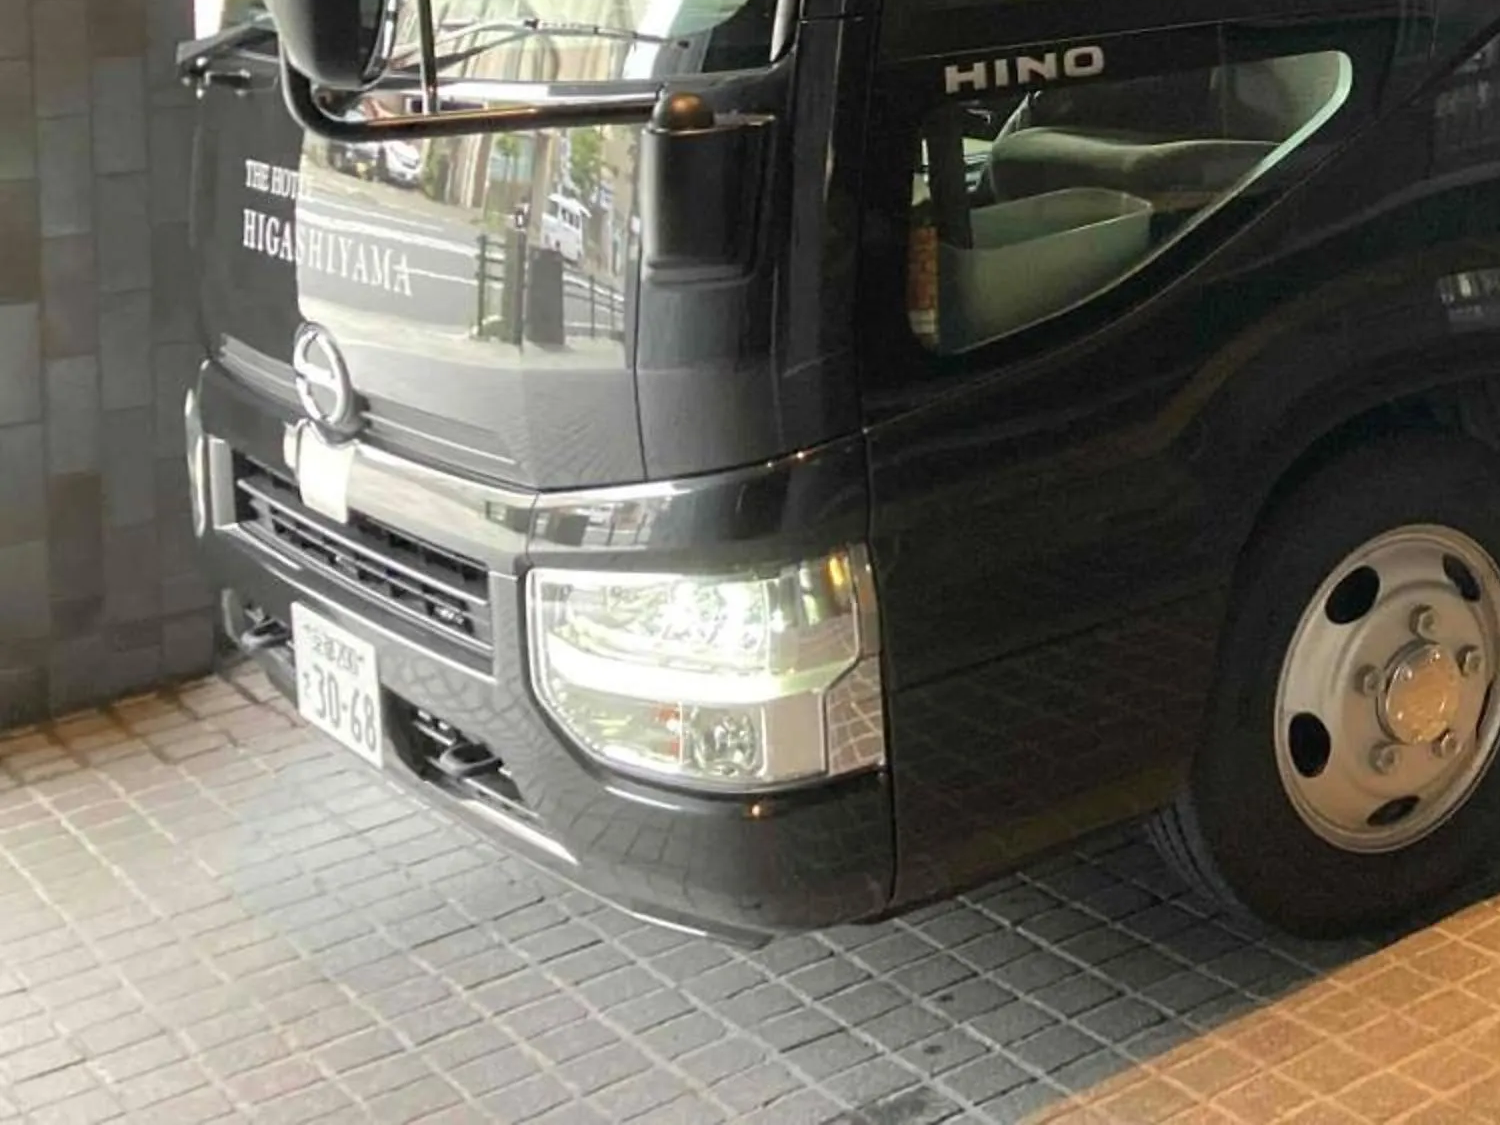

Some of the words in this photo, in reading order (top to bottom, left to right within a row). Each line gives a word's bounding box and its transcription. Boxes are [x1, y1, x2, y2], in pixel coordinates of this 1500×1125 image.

[944, 45, 1105, 94] HINO
[244, 158, 270, 192] THE
[242, 207, 413, 297] HIGASHIYAMA
[312, 662, 377, 754] 30-68
